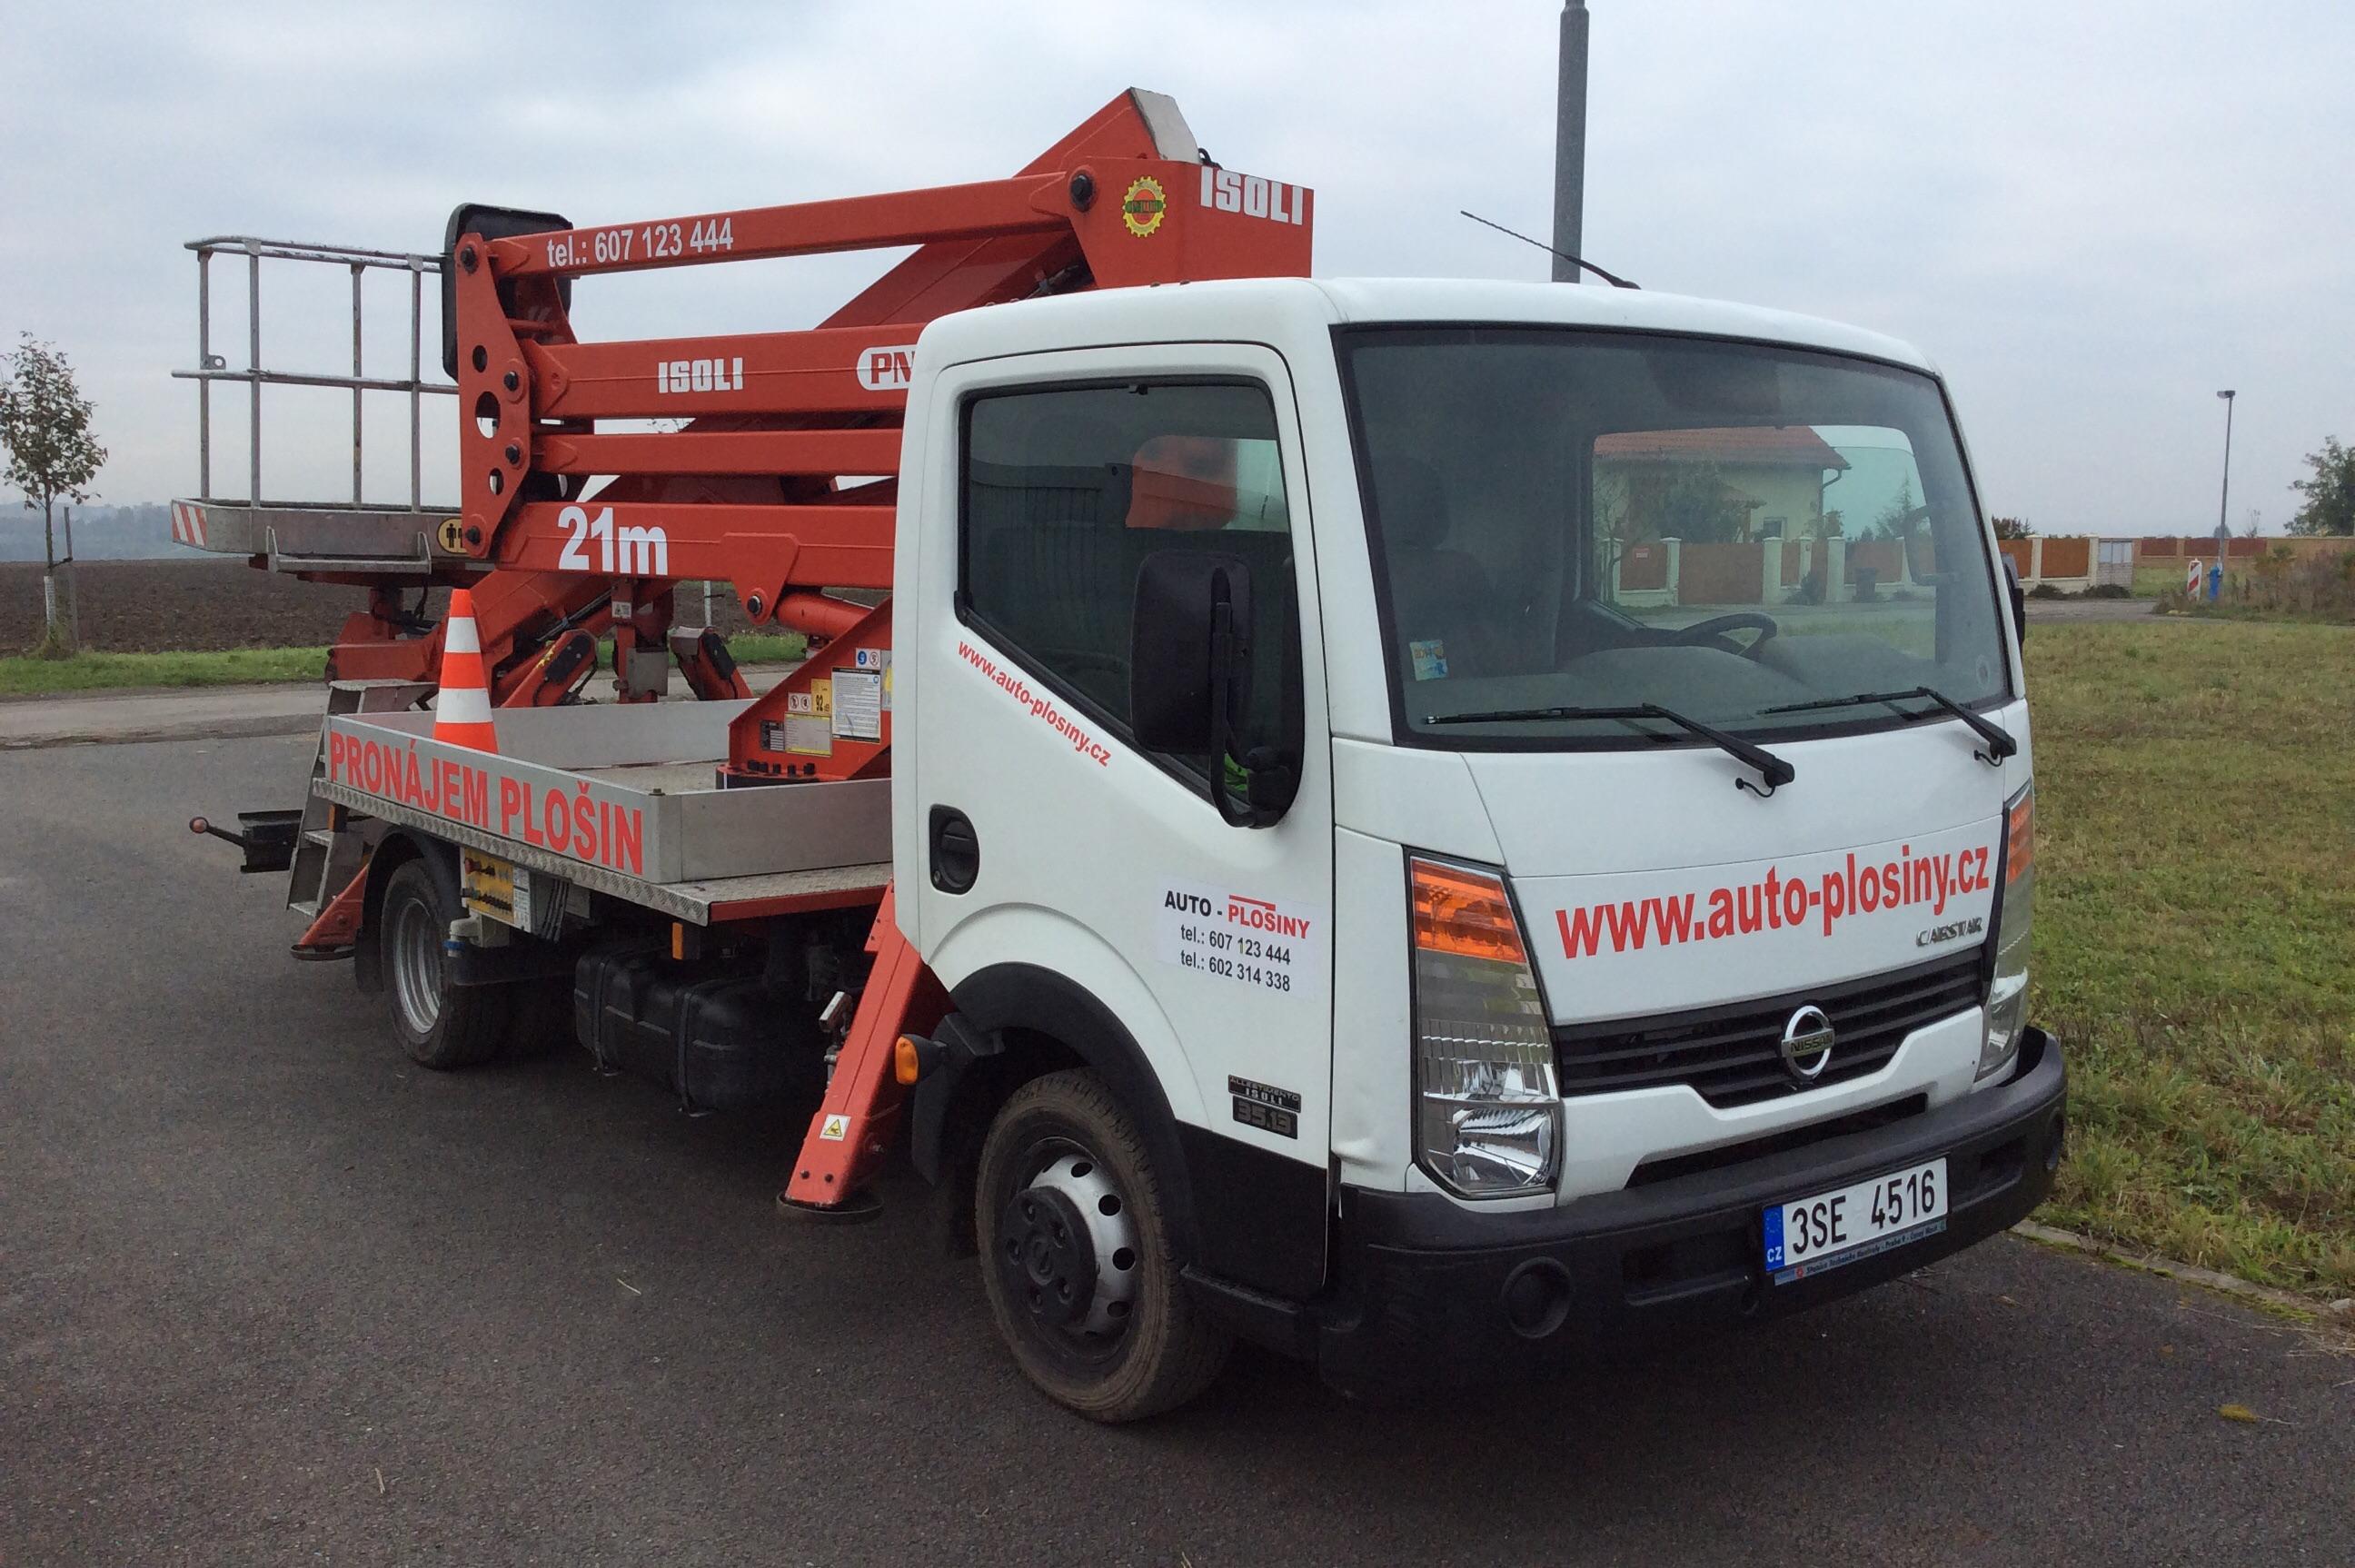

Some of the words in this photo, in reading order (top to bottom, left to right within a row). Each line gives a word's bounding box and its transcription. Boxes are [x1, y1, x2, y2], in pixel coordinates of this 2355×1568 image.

[1200, 165, 1303, 225] ISOLI
[547, 235, 587, 268] tel.:
[594, 229, 634, 263] 607
[641, 223, 682, 259] 123
[690, 217, 734, 253] 444
[658, 357, 743, 393] ISOLI
[558, 505, 668, 576] 21m
[958, 640, 1112, 768] www.auto-plosiny.cz
[330, 730, 489, 829] PRONÁJEM
[500, 777, 644, 876] PLOŠIN
[1164, 890, 1212, 918] AUTO
[1555, 844, 1989, 959] www.auto-plosiny.cz
[1180, 924, 1205, 944] tel.:
[1209, 930, 1233, 950] 607
[1237, 937, 1262, 958] 123
[1266, 944, 1291, 966] 444
[1180, 950, 1205, 970] tel.:
[1209, 957, 1233, 978] 602
[1237, 963, 1262, 985] 314
[1266, 970, 1291, 992] 338
[1790, 1032, 1833, 1053] NISSAN
[1246, 1087, 1282, 1105] ISOLI
[1792, 1195, 1847, 1255] 3SE
[1871, 1169, 1935, 1229] 4516
[1766, 1246, 1783, 1263] CZ
